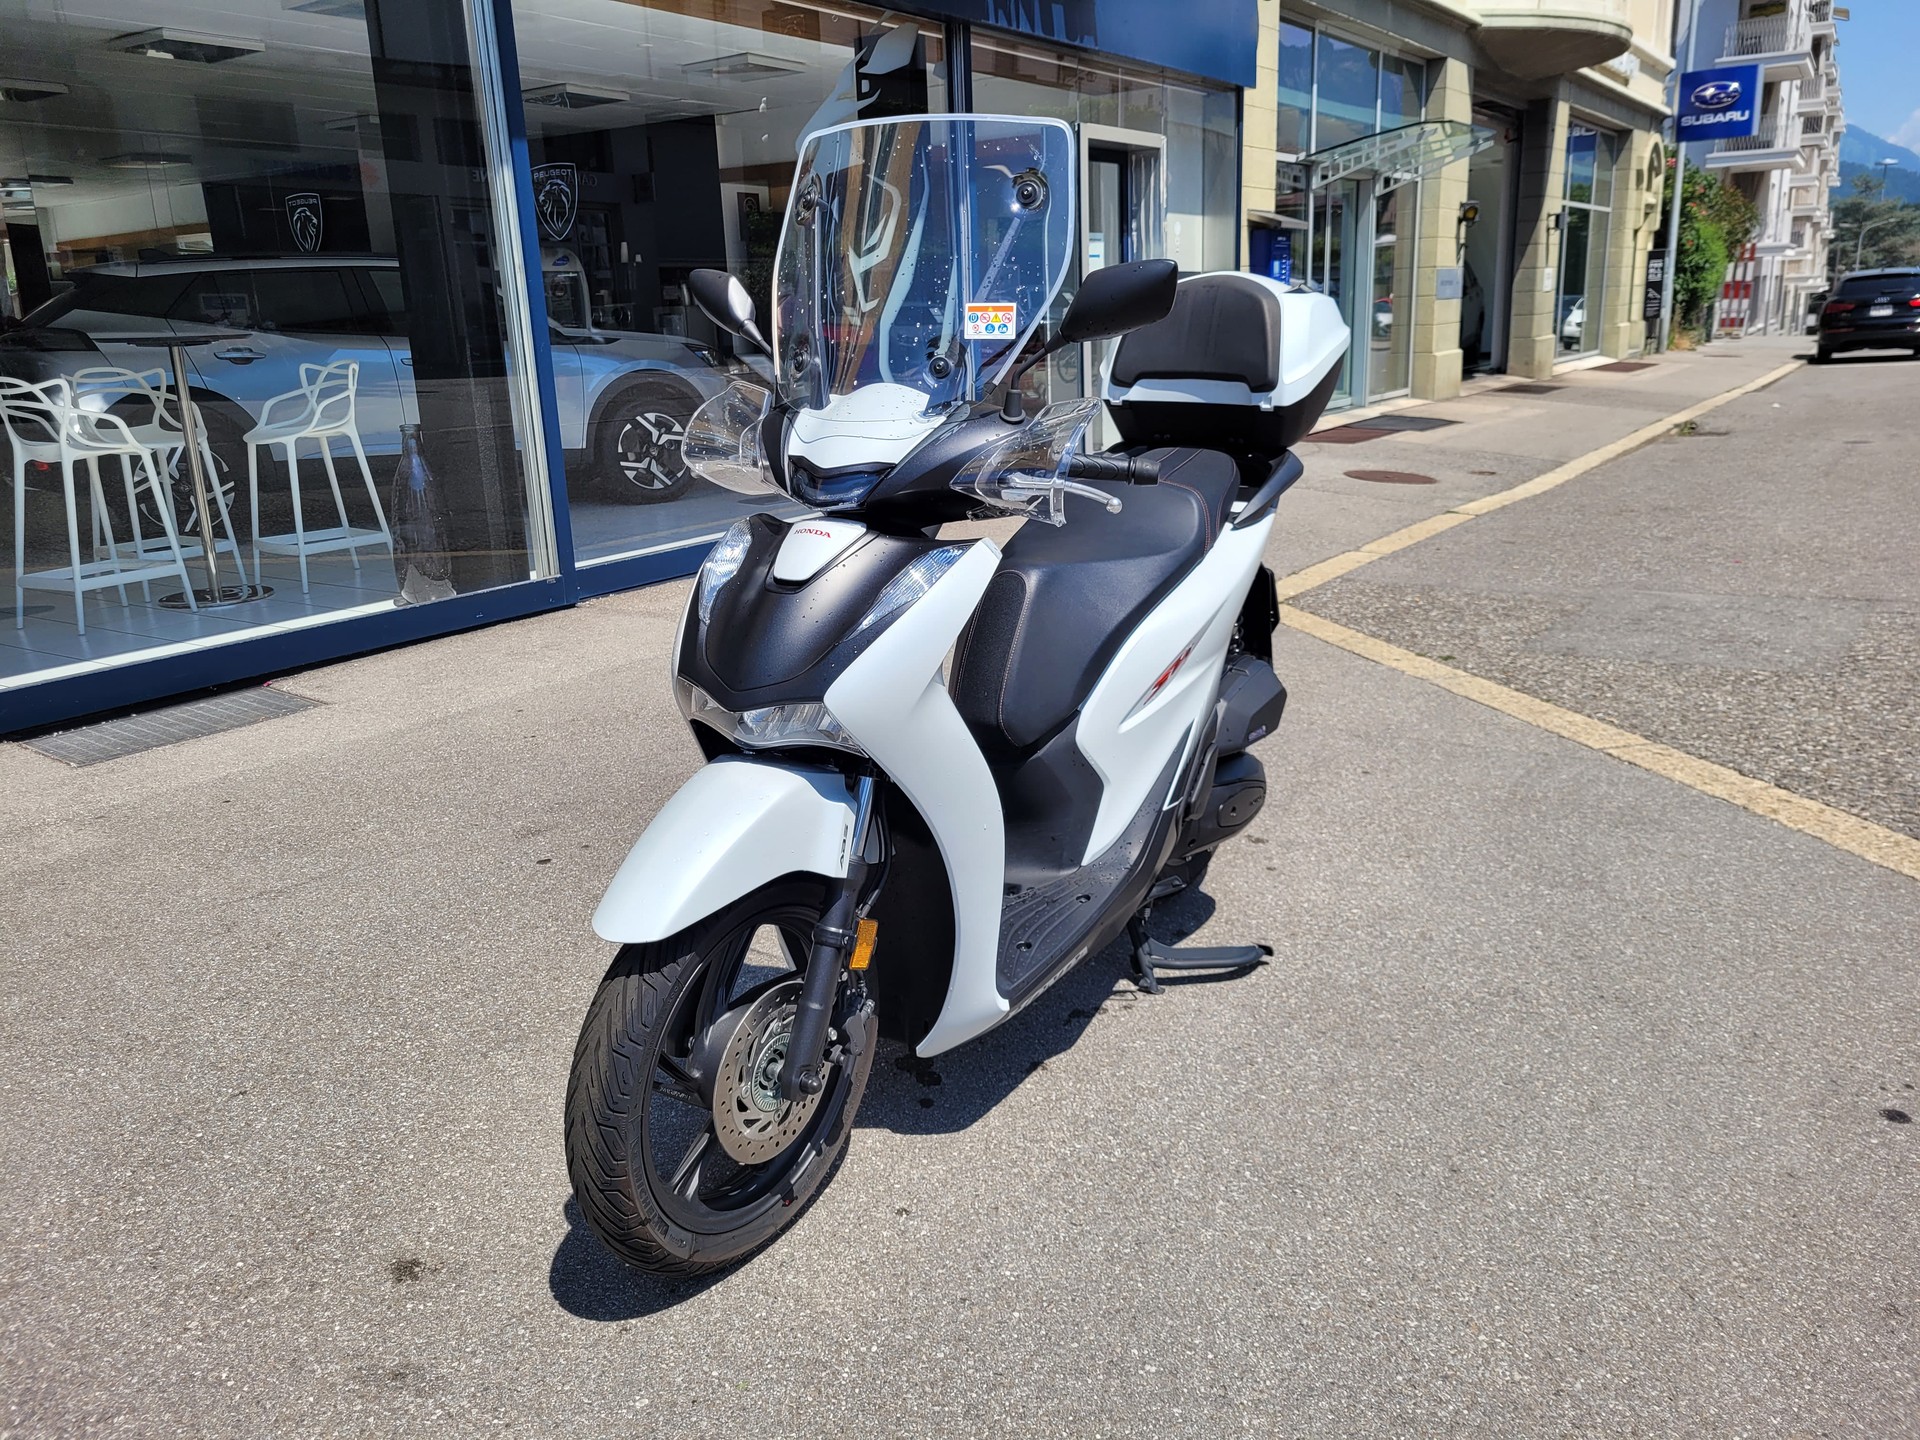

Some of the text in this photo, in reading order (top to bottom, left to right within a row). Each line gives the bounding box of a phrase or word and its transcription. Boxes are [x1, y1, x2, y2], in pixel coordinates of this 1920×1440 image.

[1681, 110, 1750, 127] SUBARU
[533, 168, 572, 179] PEUGEOT
[794, 528, 831, 539] HONDA
